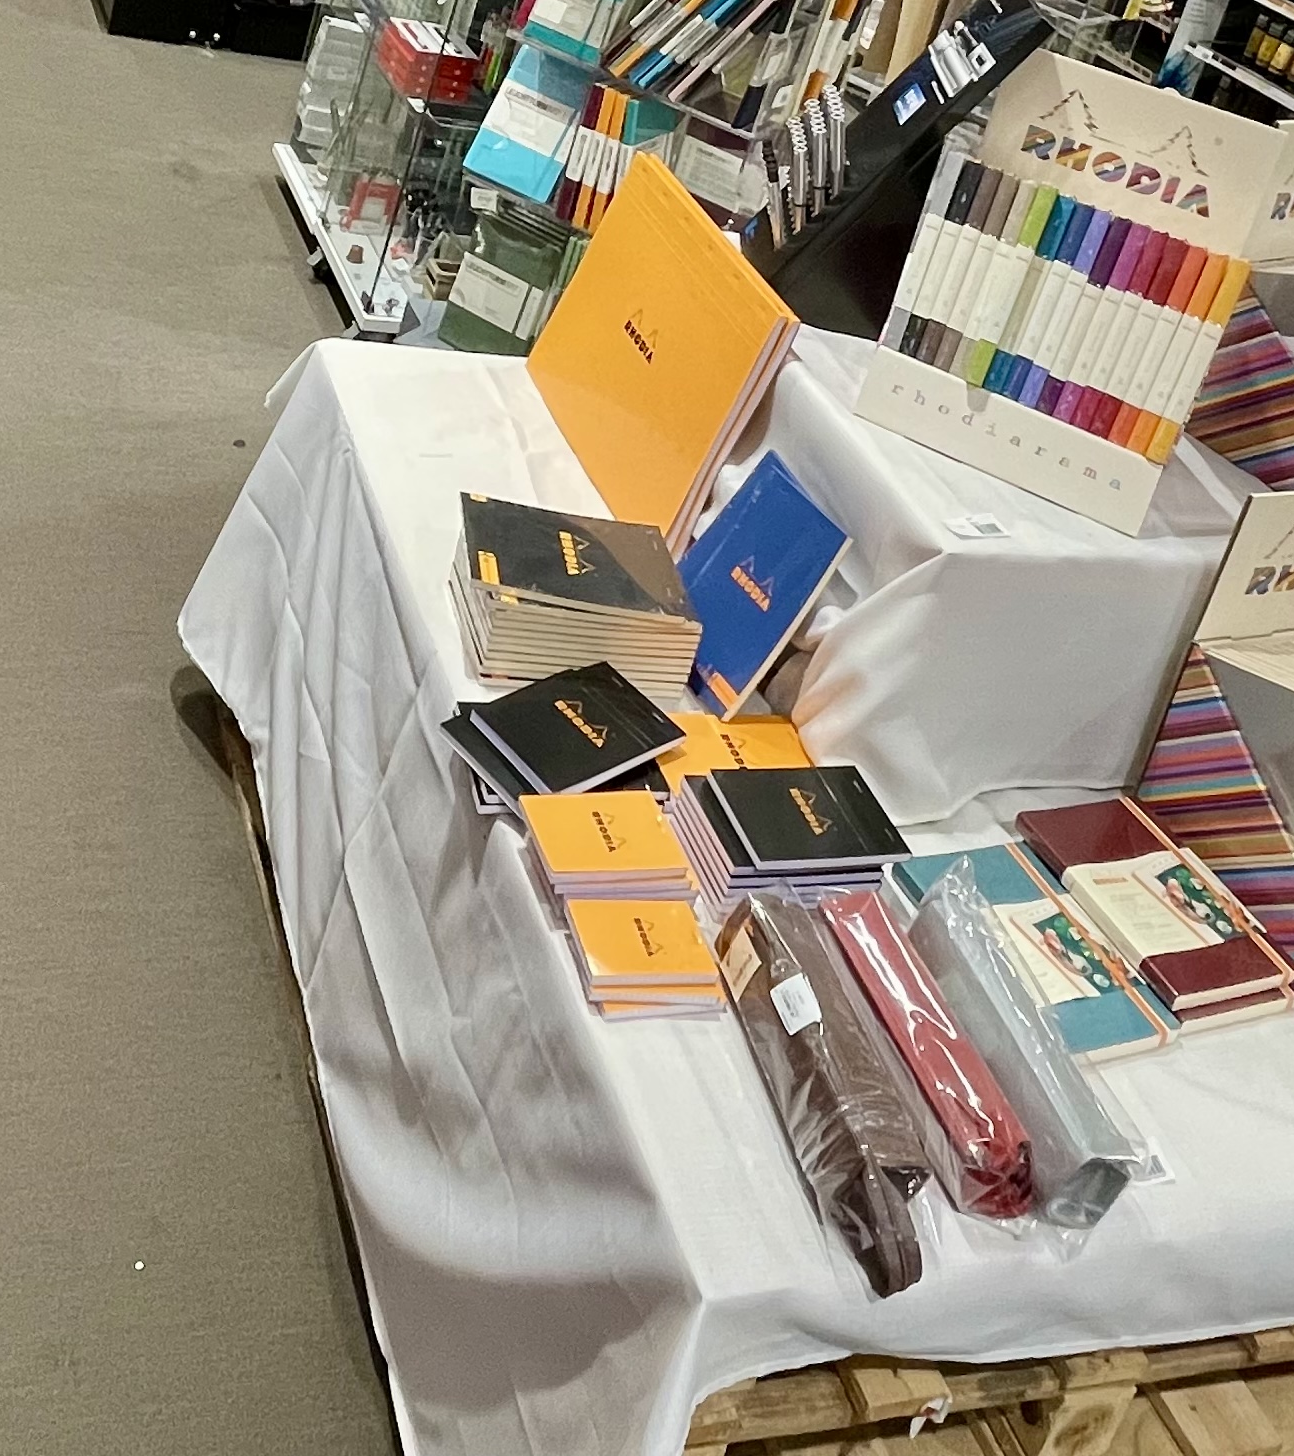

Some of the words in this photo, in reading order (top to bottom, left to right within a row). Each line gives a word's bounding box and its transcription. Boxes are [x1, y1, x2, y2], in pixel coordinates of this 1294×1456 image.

[1019, 123, 1210, 219] RHODIA
[624, 319, 654, 365] RHODIA
[891, 381, 1122, 492] rhodiarama
[729, 564, 772, 613] RHODIA
[720, 733, 746, 768] RHOD
[591, 810, 617, 854] RHODIA
